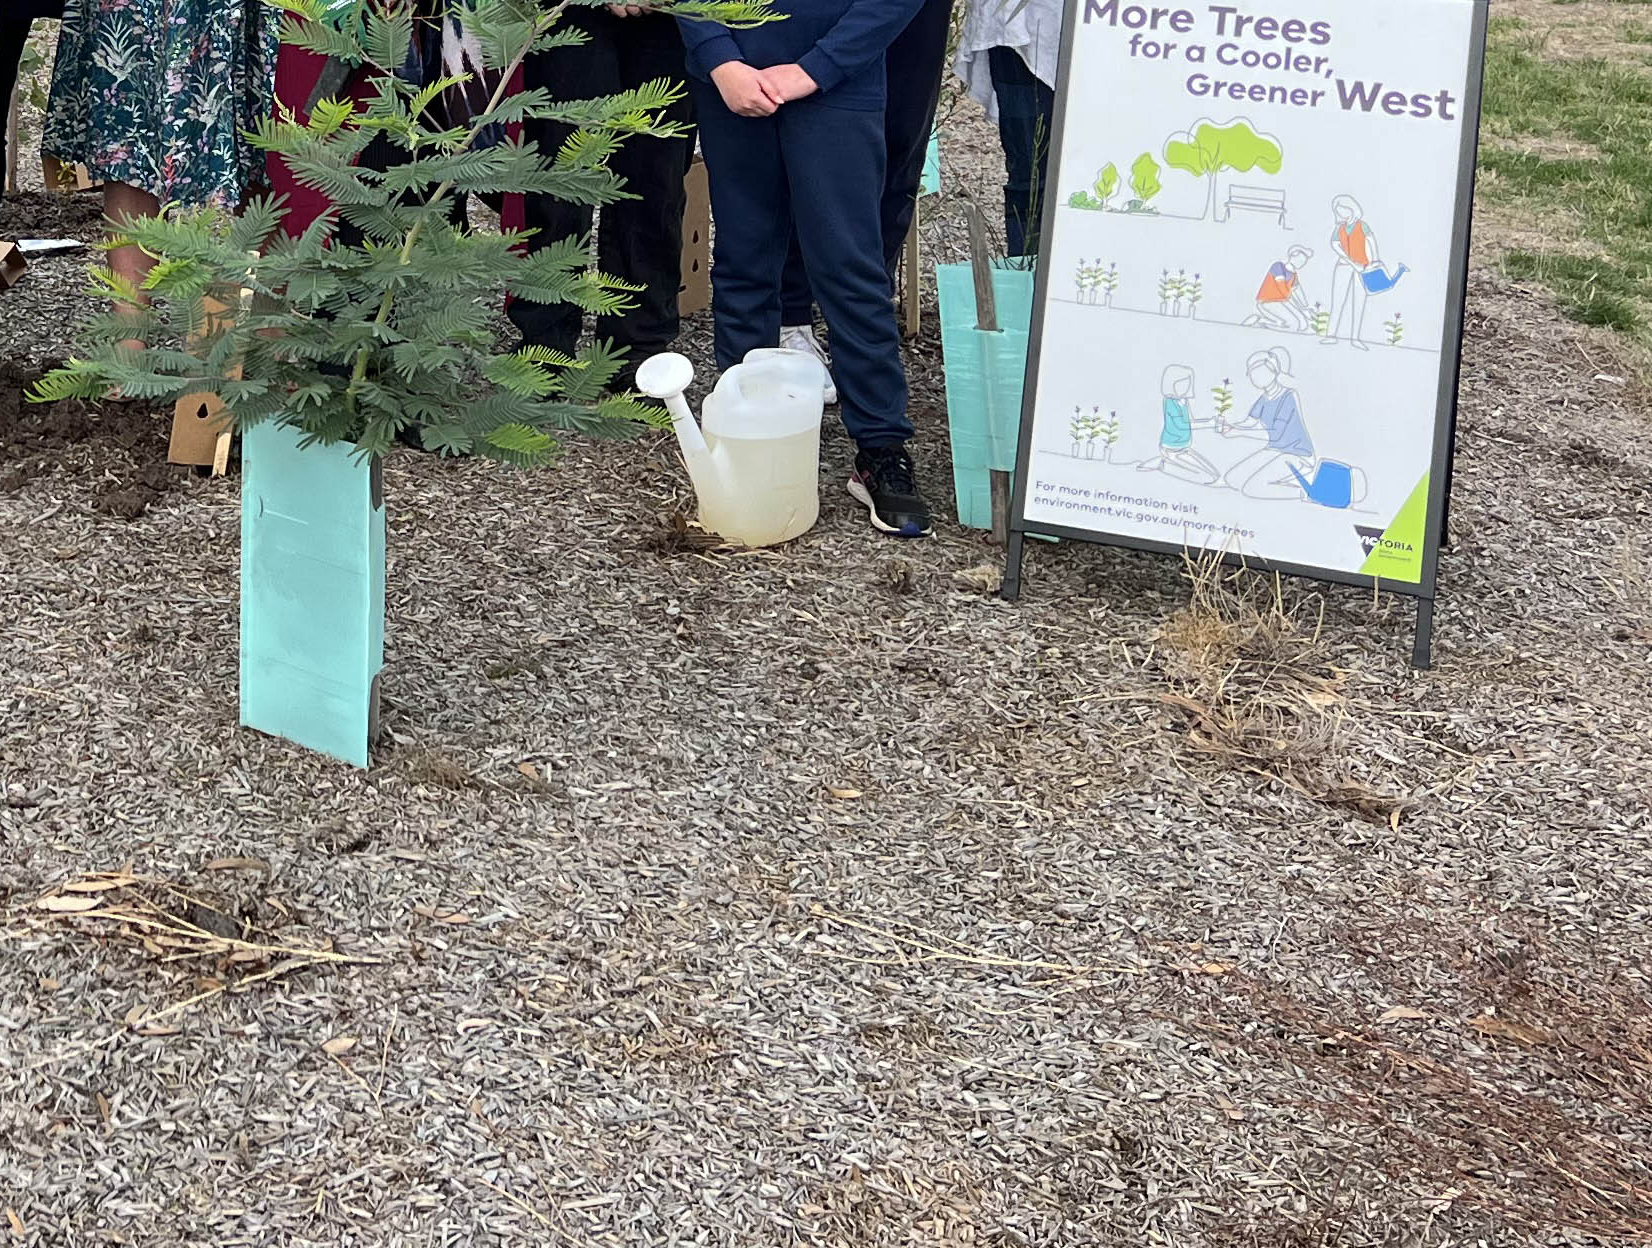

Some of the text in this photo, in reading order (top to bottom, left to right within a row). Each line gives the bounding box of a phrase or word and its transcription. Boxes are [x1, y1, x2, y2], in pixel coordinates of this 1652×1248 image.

[1208, 5, 1331, 46] Trees
[1128, 33, 1334, 79] for a Cooler,
[1186, 73, 1456, 121] Greener West
[1035, 480, 1199, 515] For more information visit
[1358, 535, 1413, 551] VICTORIA
